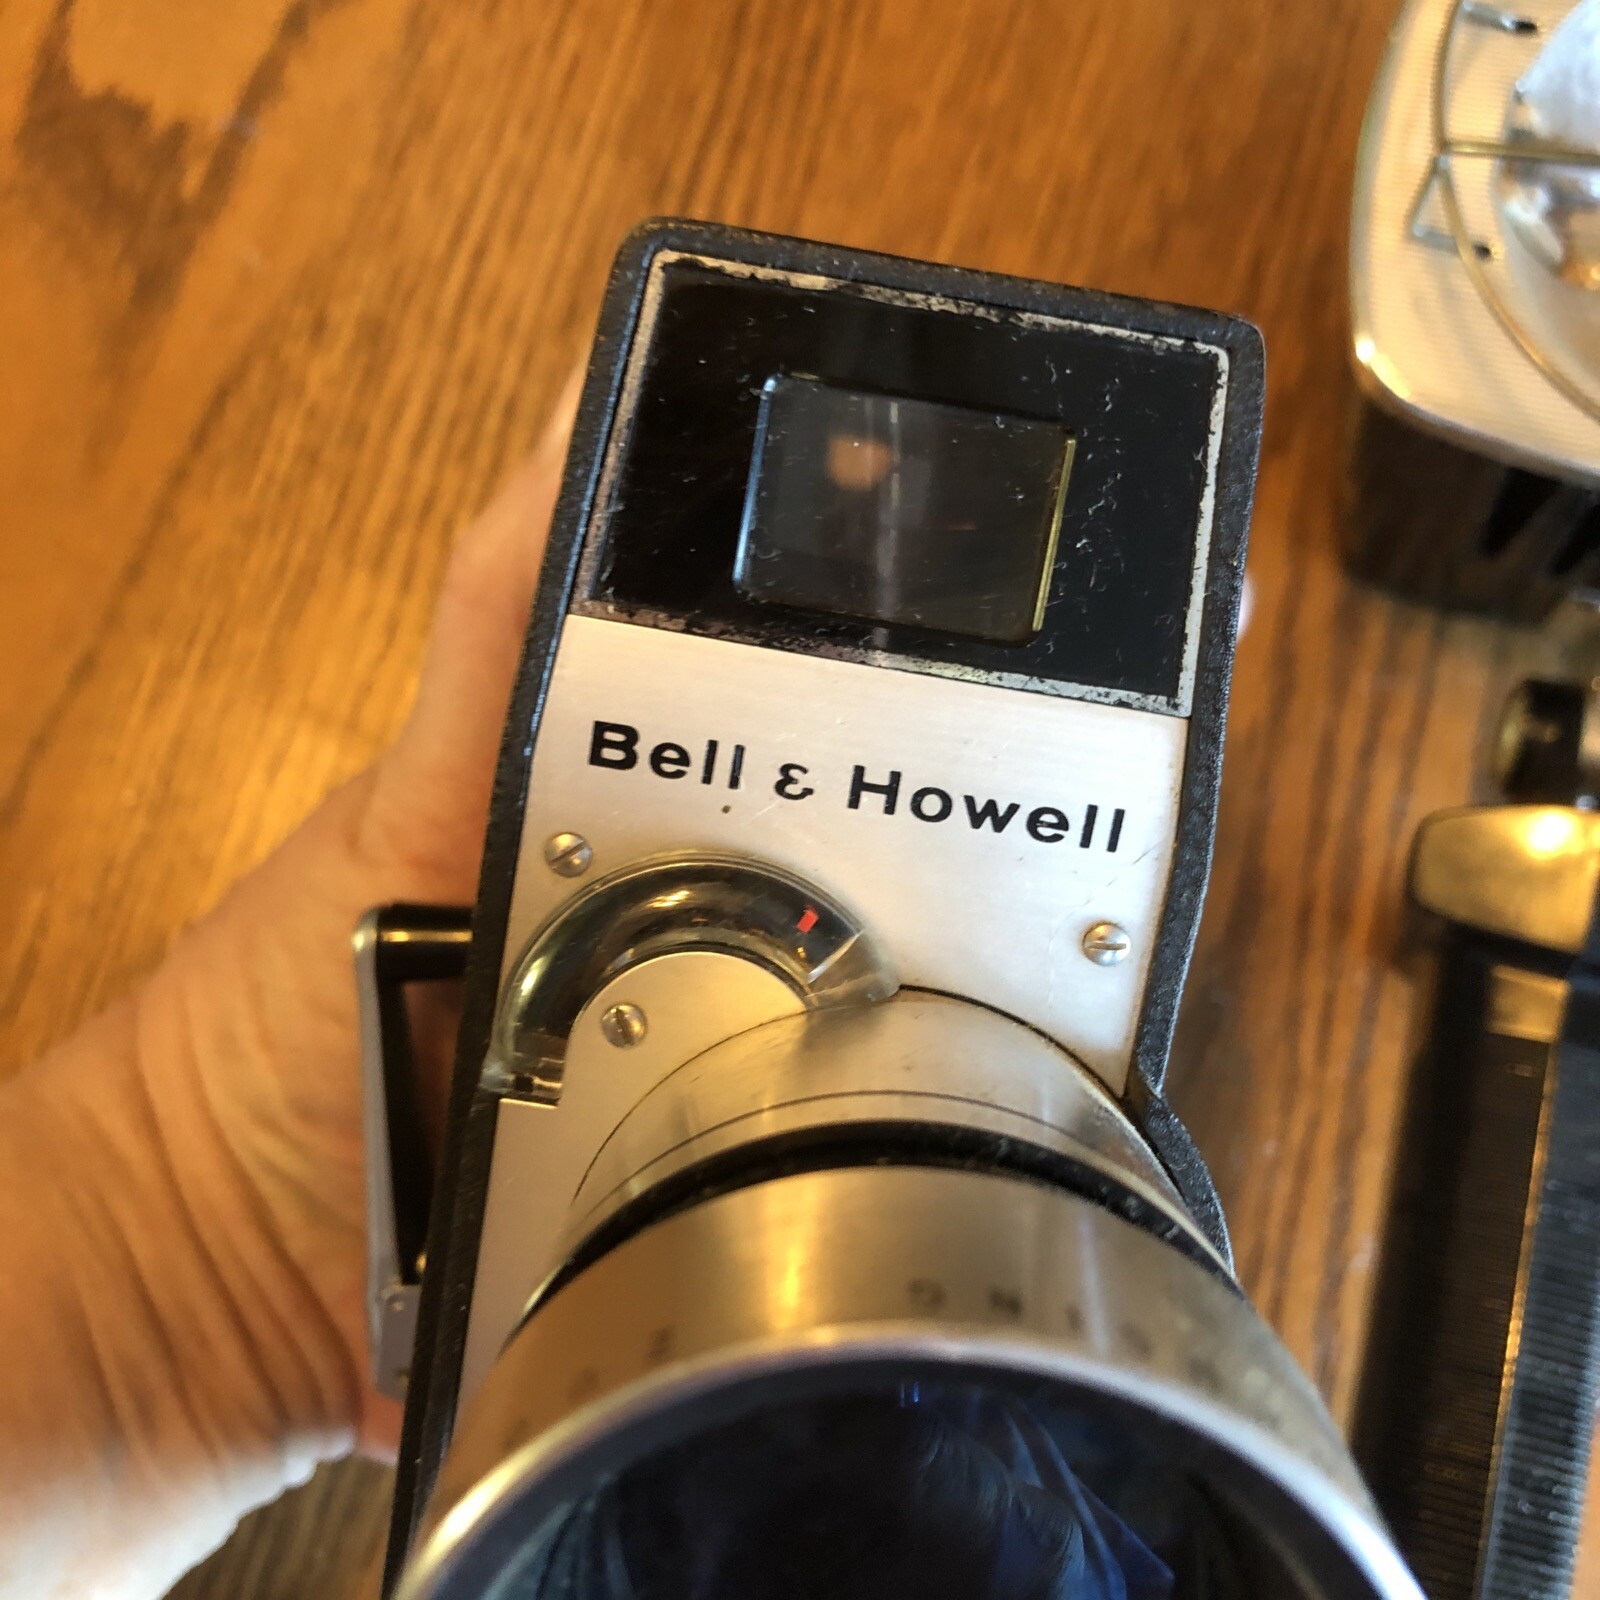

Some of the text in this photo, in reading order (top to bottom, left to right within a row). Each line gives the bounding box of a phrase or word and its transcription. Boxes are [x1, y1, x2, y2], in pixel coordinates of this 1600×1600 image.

[588, 720, 1126, 853] Bell & Howell
